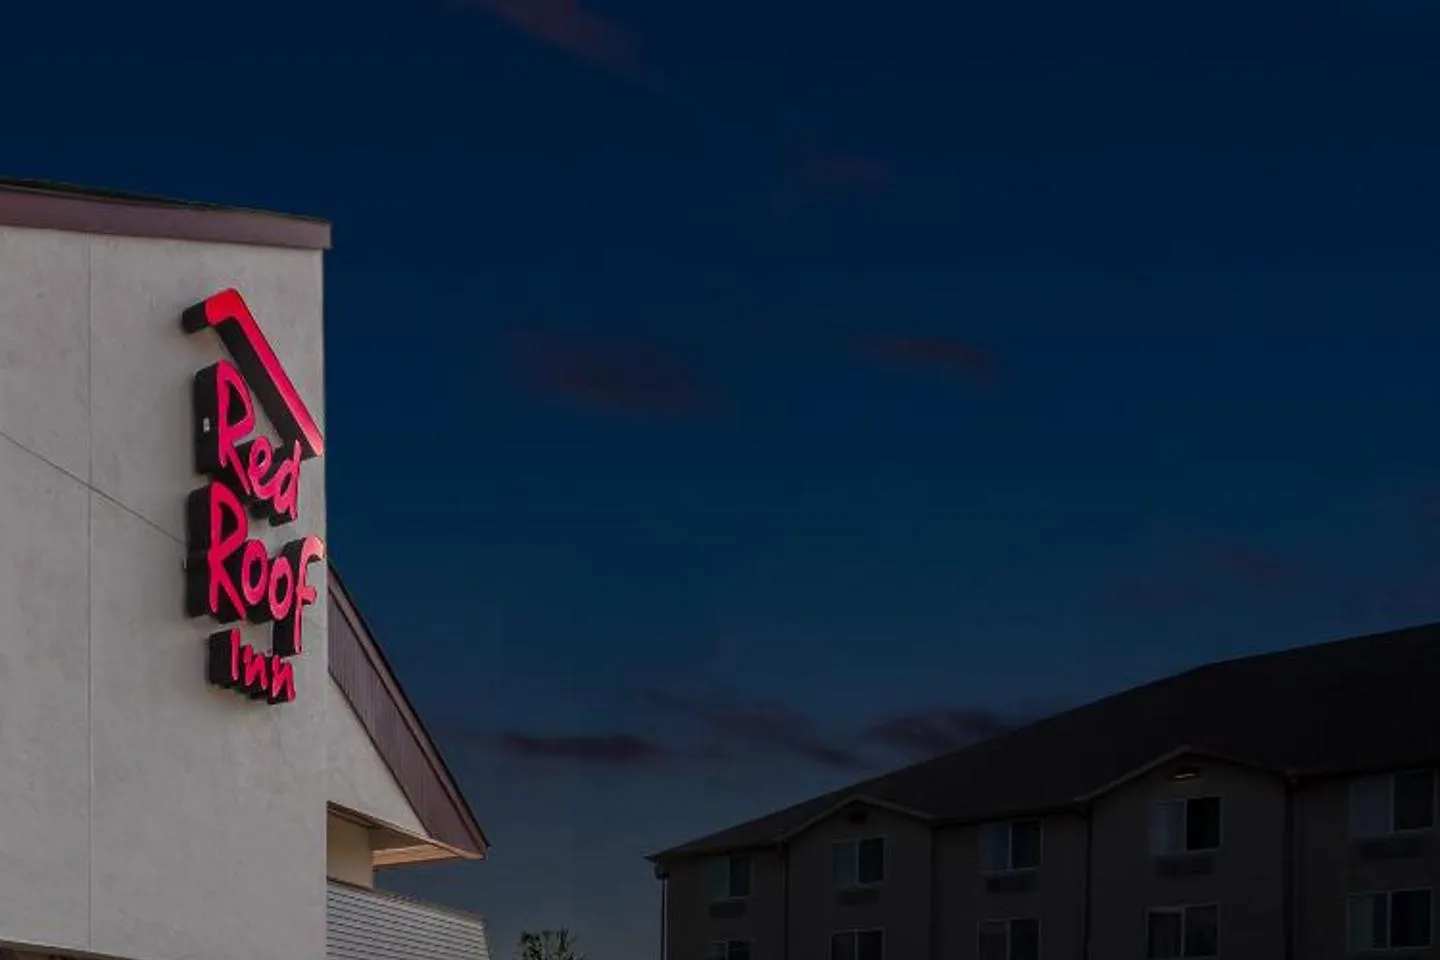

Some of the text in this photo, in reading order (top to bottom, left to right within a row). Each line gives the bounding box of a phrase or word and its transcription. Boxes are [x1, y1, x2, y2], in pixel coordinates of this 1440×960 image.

[216, 359, 301, 520] Red
[207, 481, 324, 656] Roof
[230, 628, 296, 701] Inn
